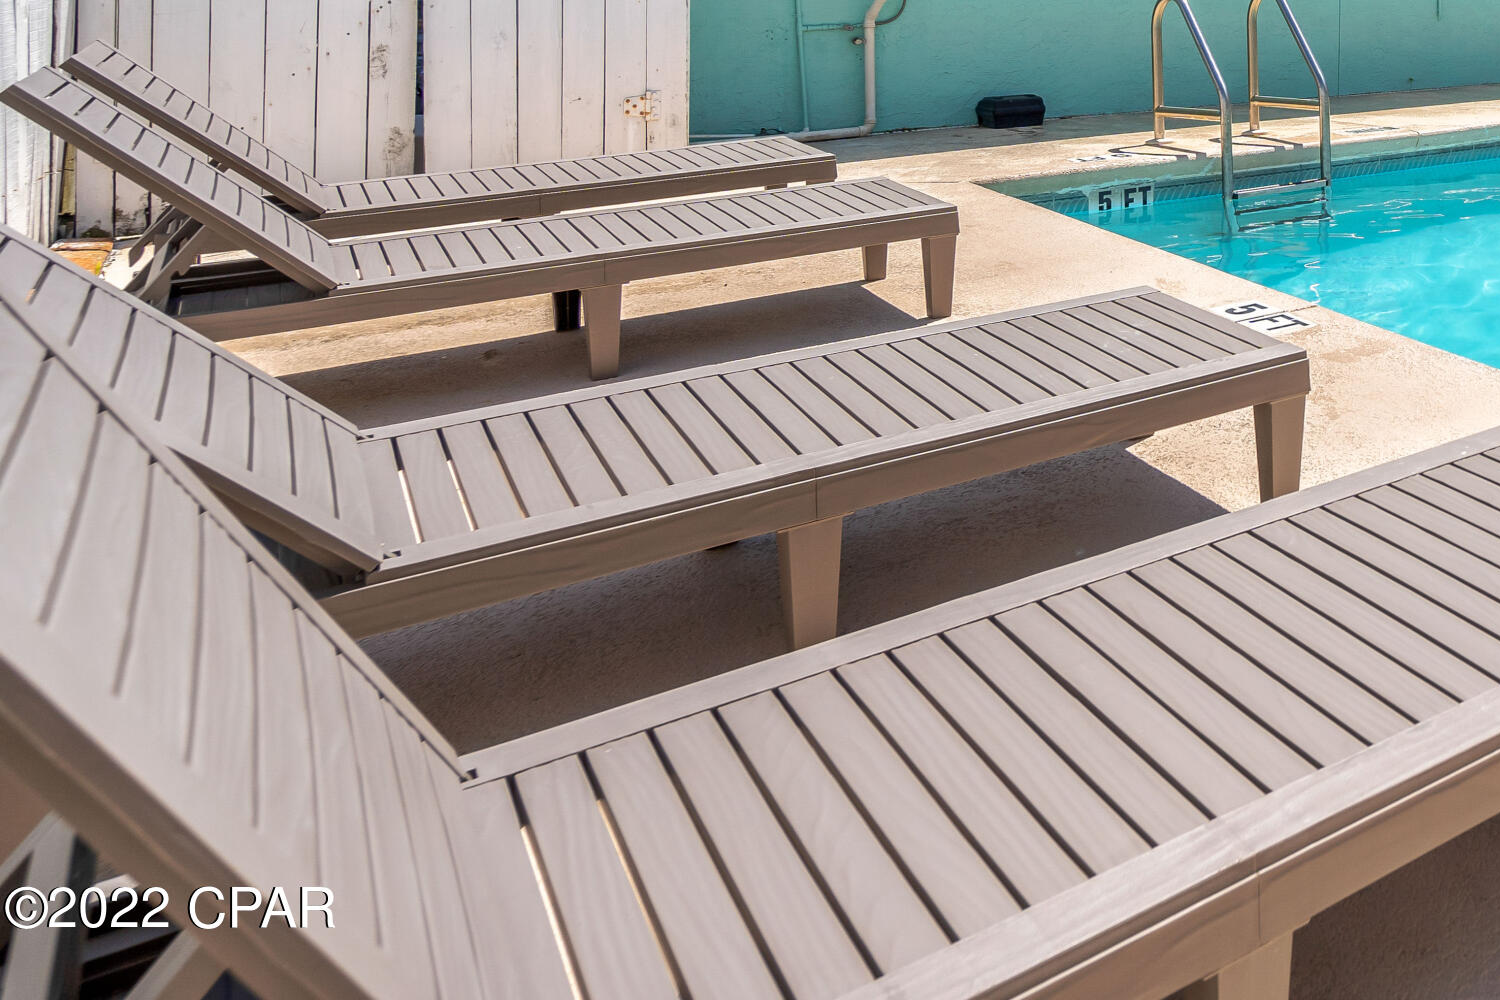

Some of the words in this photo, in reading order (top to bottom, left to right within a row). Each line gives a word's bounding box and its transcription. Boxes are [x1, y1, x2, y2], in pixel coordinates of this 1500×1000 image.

[1098, 190, 1112, 211] 5
[1124, 186, 1151, 208] FT
[1225, 303, 1268, 315] 5
[1249, 314, 1310, 331] FT
